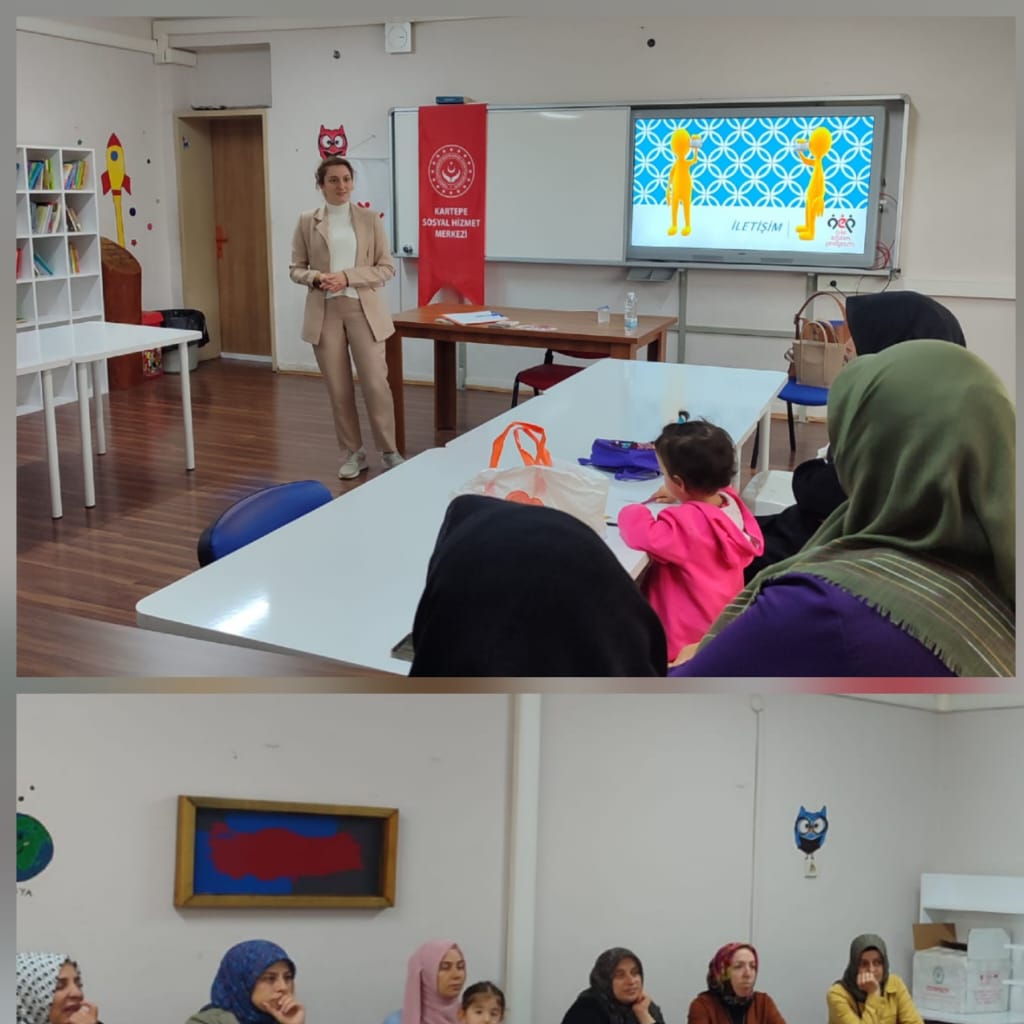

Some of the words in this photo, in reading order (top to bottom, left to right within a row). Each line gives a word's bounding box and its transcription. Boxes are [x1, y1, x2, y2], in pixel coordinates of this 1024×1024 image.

[434, 207, 468, 216] KARTEPE
[422, 218, 450, 227] SOSYAL
[451, 217, 480, 227] HİZMET
[731, 219, 783, 234] İLETİŞİM
[434, 229, 468, 239] MERKEZİ
